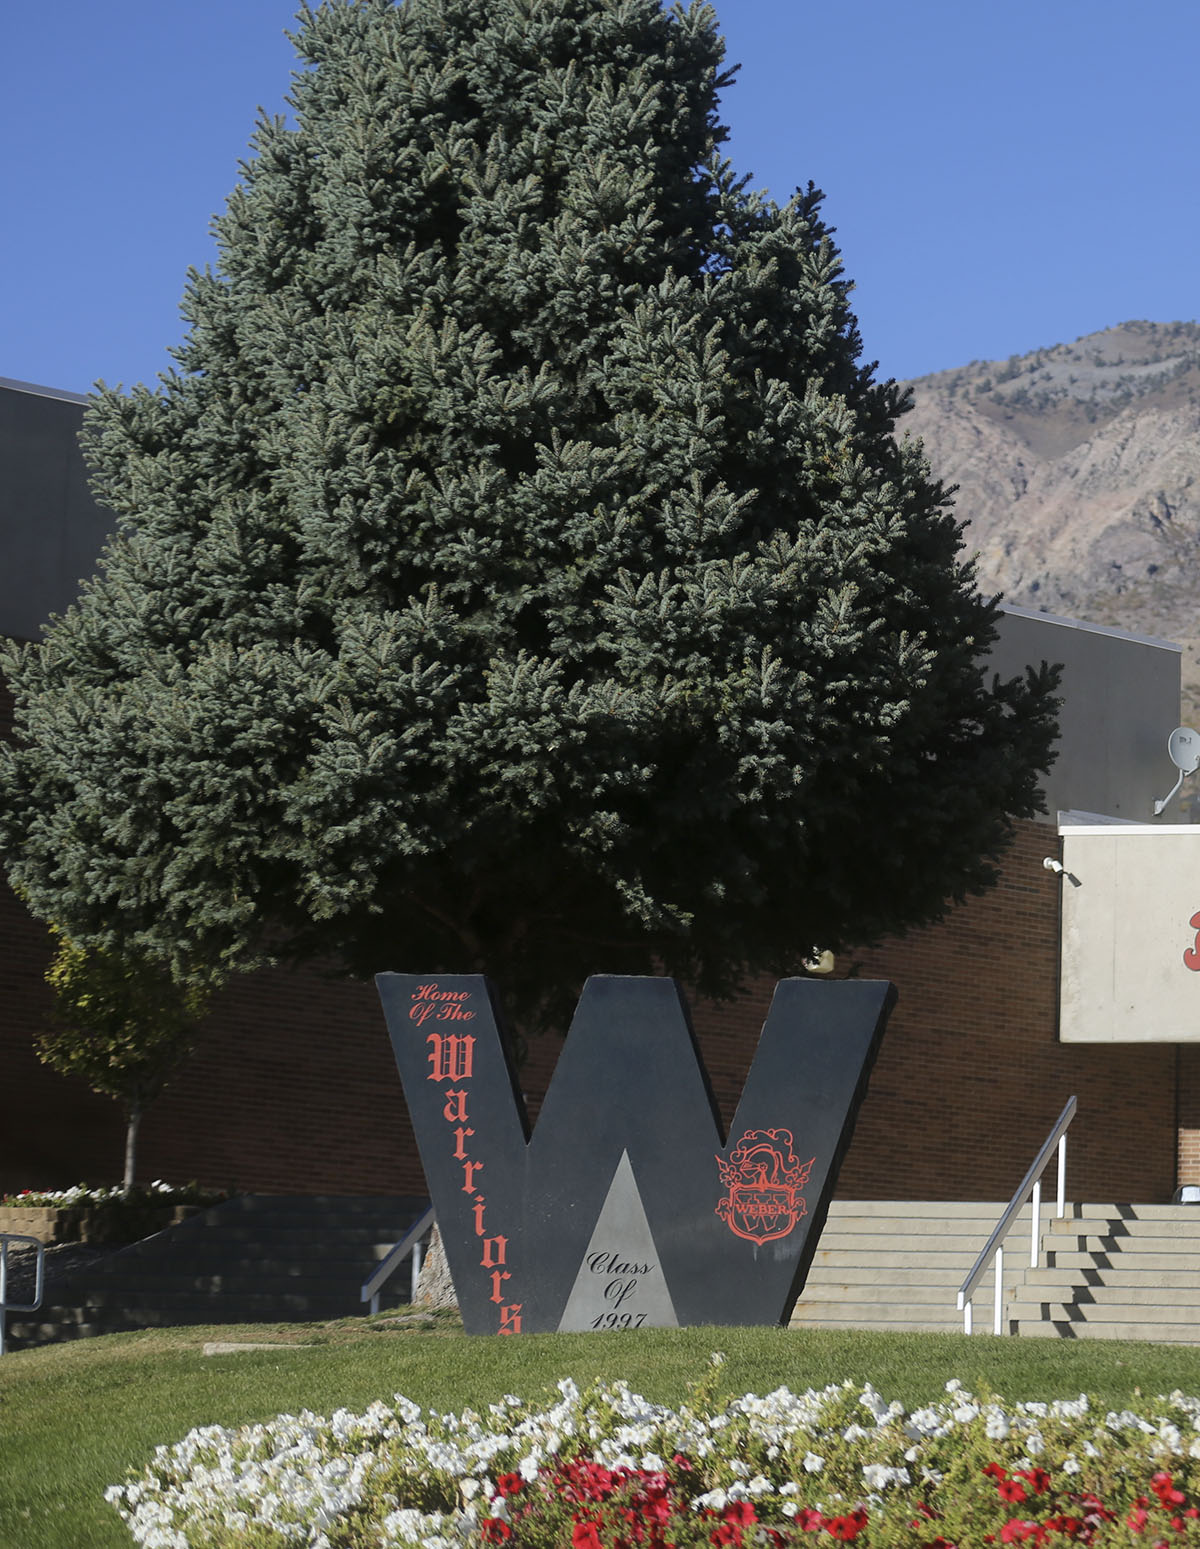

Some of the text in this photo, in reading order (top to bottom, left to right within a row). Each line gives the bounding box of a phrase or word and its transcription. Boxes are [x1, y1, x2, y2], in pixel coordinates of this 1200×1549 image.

[411, 983, 472, 1002] Home
[409, 1002, 477, 1027] Of The
[426, 1033, 523, 1336] Warriors
[735, 1204, 791, 1215] WEBER
[586, 1251, 656, 1275] Class
[603, 1277, 638, 1310] Of
[590, 1312, 648, 1329] 1997
